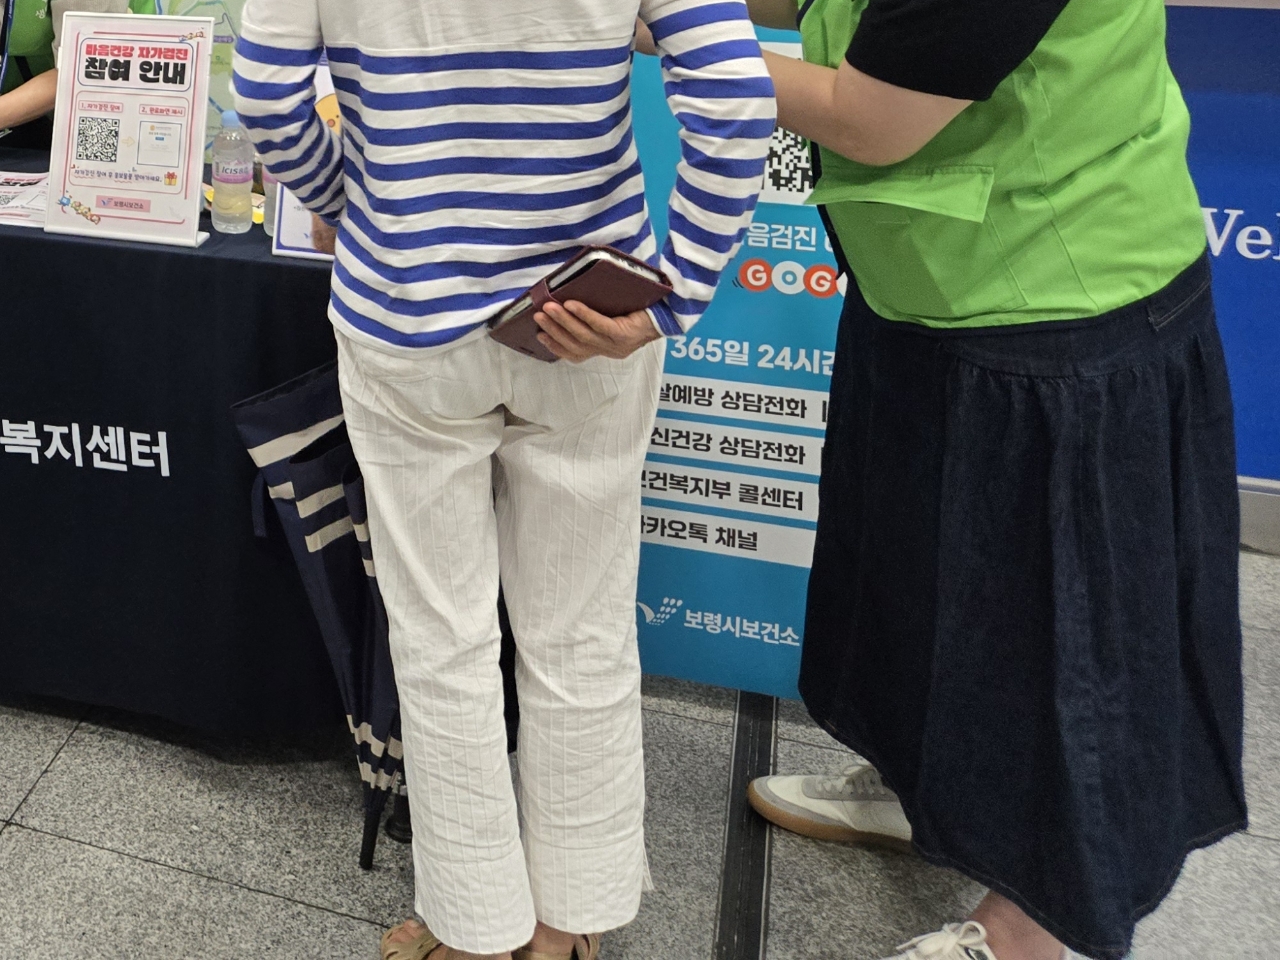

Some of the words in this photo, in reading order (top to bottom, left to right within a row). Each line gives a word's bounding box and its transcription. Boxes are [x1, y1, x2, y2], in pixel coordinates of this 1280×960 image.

[85, 44, 134, 58] 마음건강
[137, 46, 189, 60] 자가검진
[84, 57, 131, 82] 참여
[139, 61, 186, 85] 안내
[741, 222, 817, 252] 음검진
[670, 335, 749, 367] 365일
[721, 389, 807, 419] 상담전화
[719, 435, 806, 465] 상담전화
[738, 483, 804, 512] 콜센터
[715, 525, 758, 552] 채널
[683, 609, 800, 647] 보령시보건소
